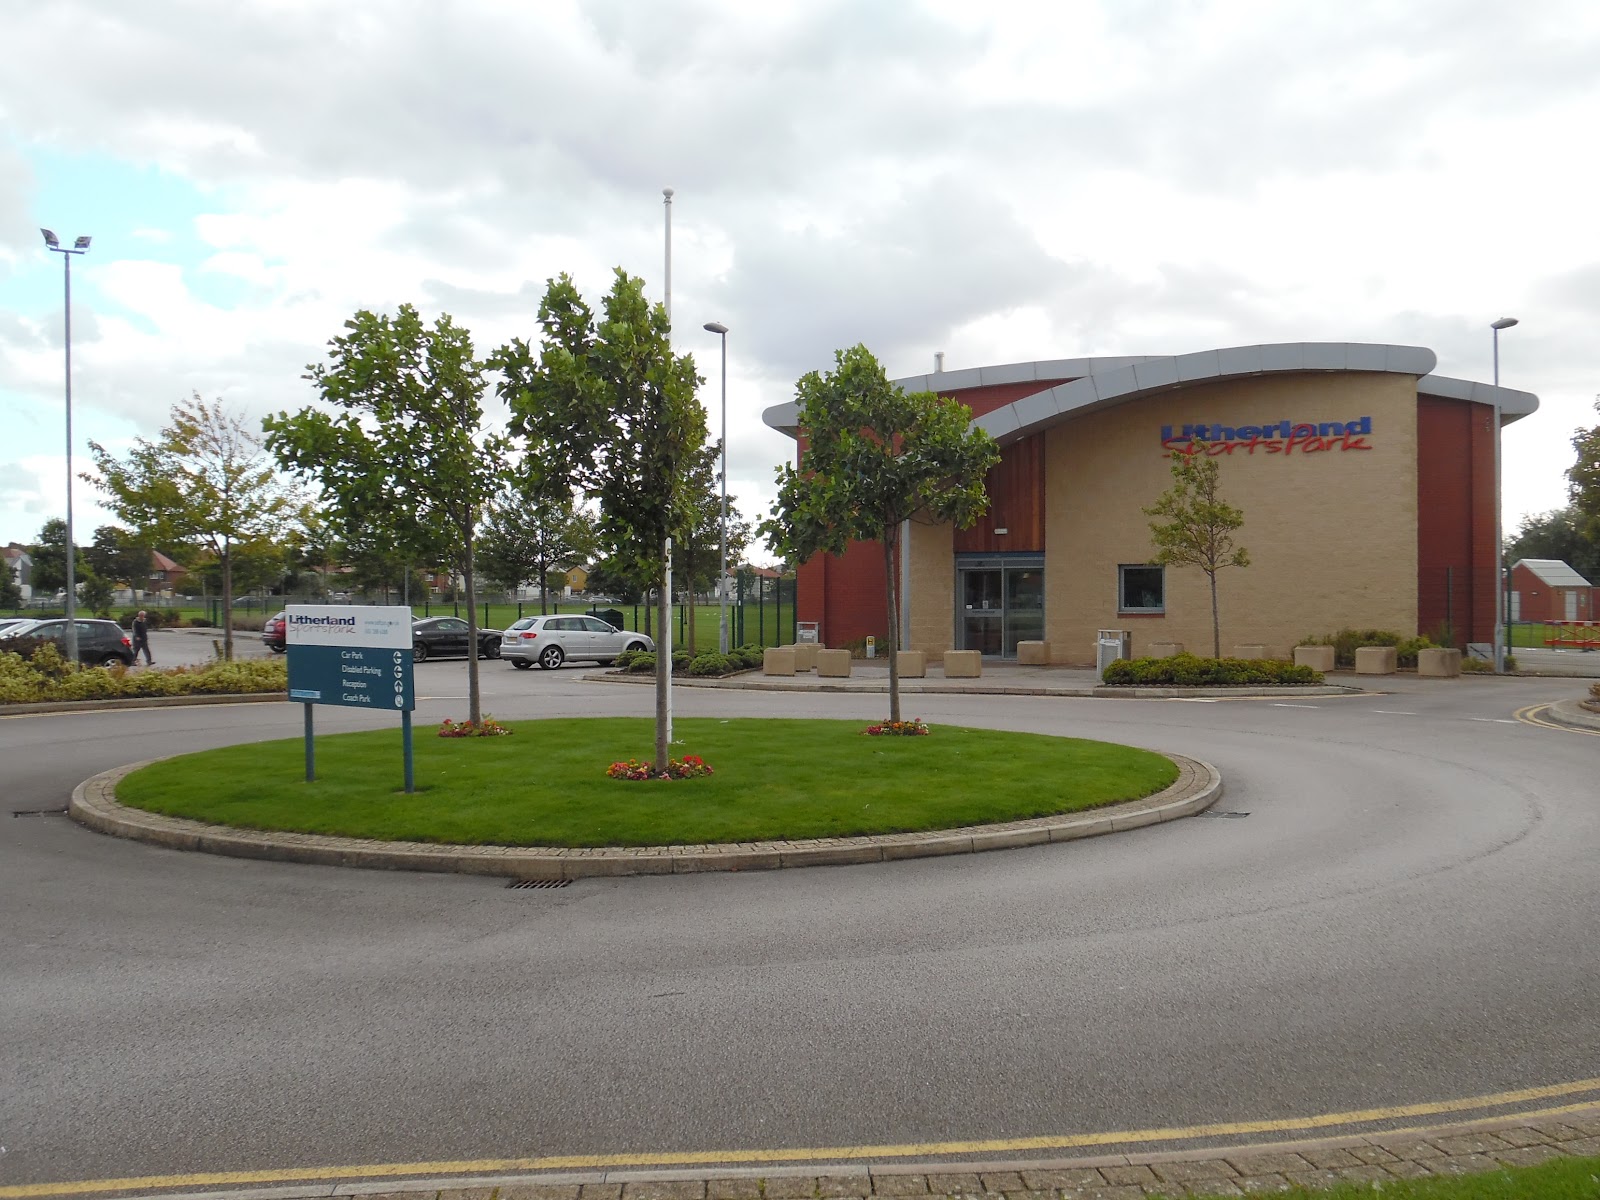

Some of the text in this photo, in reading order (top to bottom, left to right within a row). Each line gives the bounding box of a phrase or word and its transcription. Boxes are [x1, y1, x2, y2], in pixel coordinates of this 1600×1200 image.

[1161, 416, 1371, 442] Litherland
[289, 615, 355, 626] Litherland
[341, 651, 363, 660] Car Park
[342, 665, 382, 677] Disabled Parking
[342, 679, 366, 689] Reception
[342, 694, 370, 703] Coach Park
